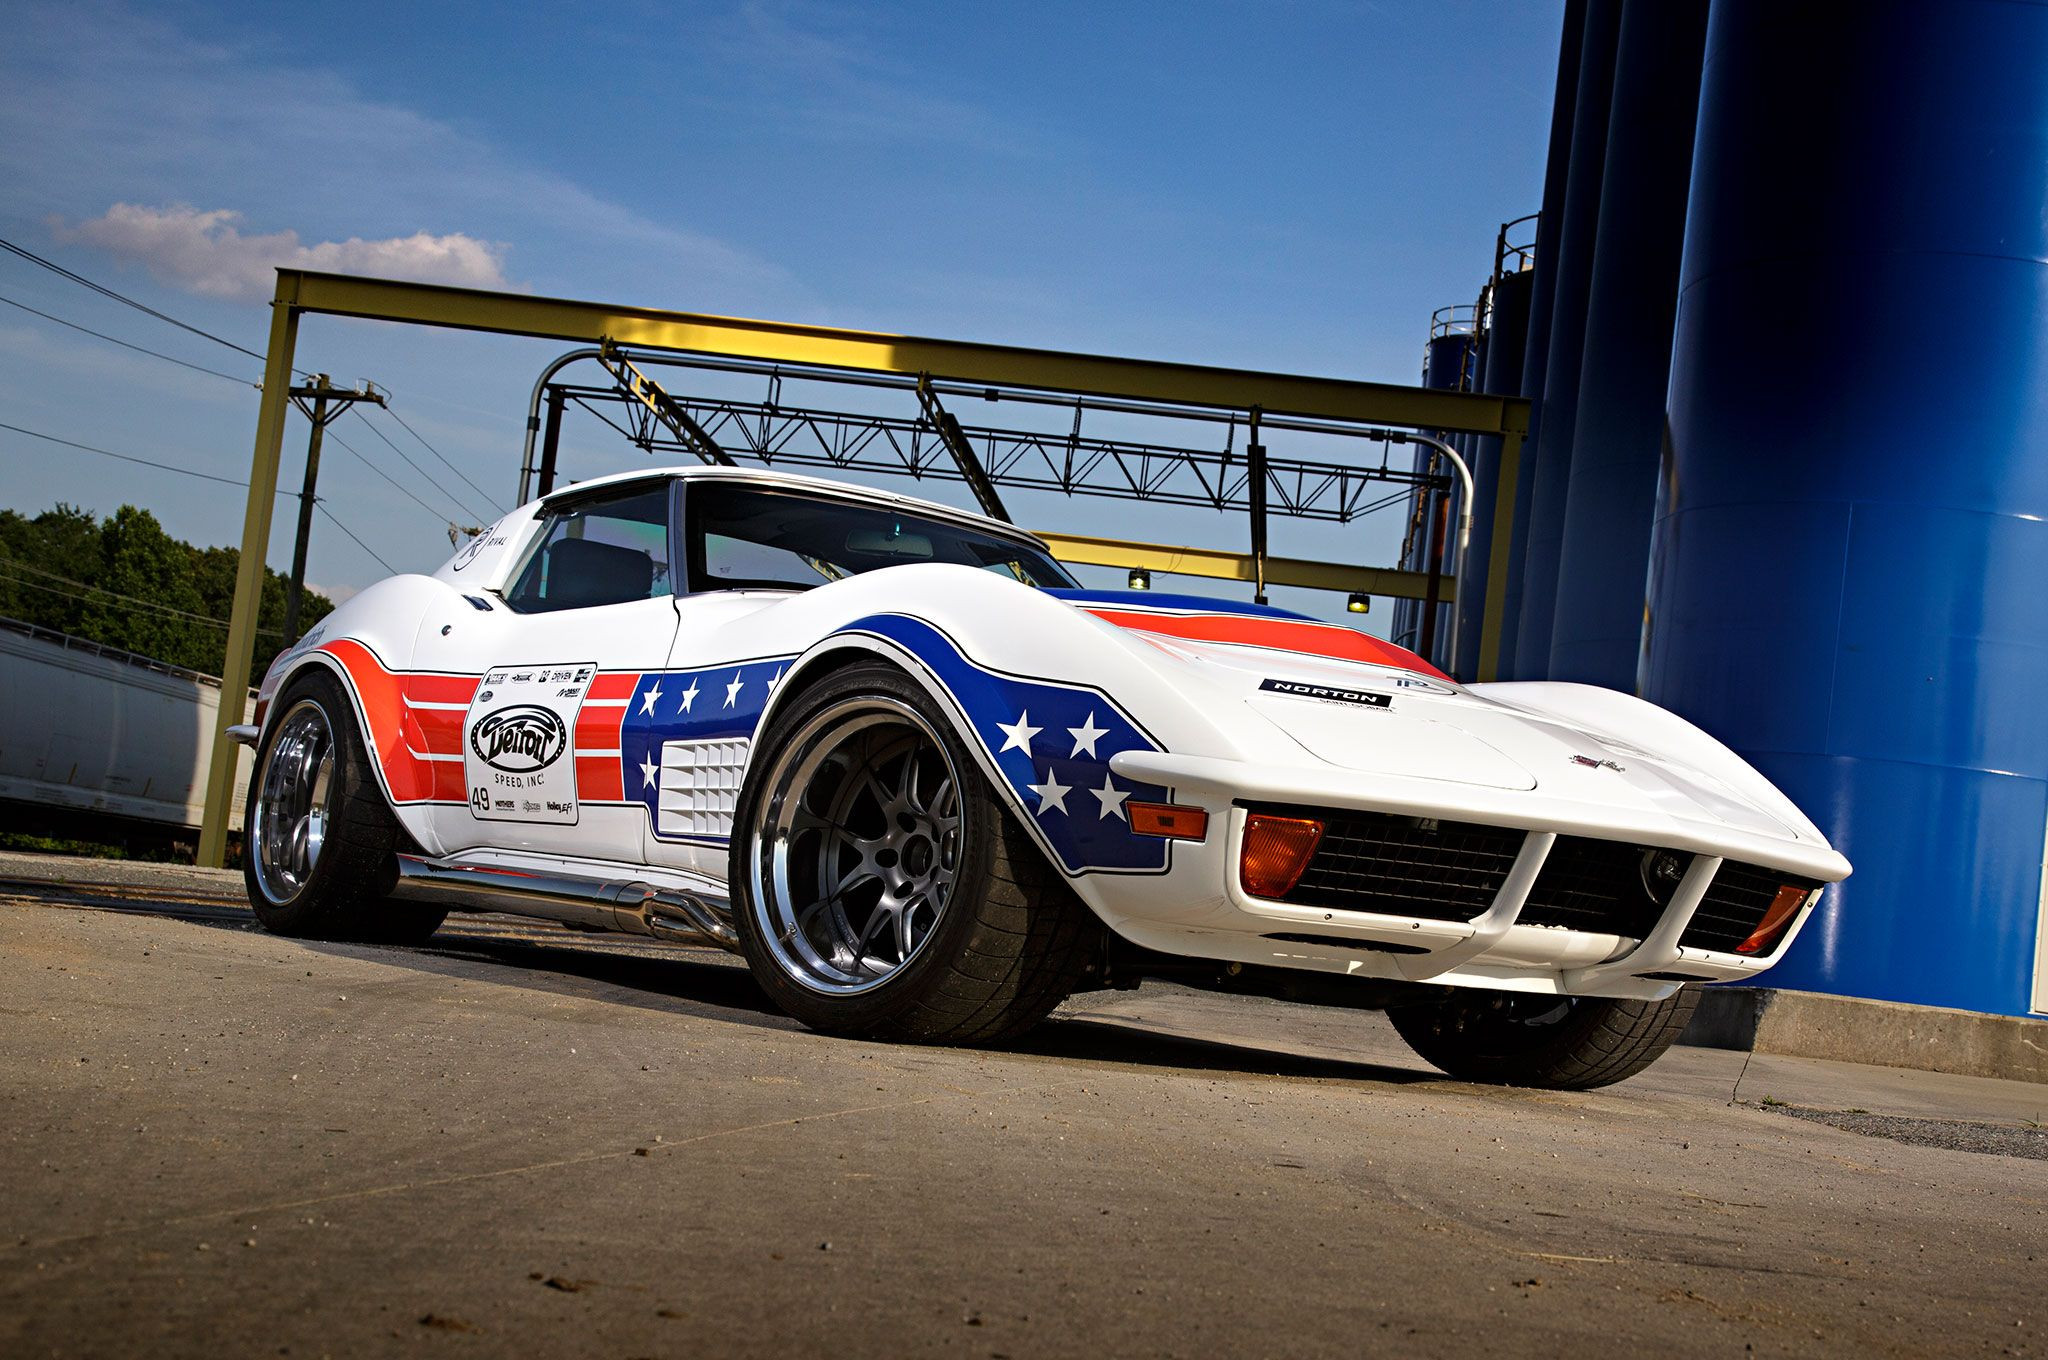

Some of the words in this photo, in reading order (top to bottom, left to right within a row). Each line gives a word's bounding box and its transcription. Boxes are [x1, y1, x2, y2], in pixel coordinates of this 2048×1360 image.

[1274, 682, 1378, 703] NORTON
[495, 773, 524, 789] SPEED,
[472, 787, 490, 811] 49
[495, 800, 515, 809] MOTHERS
